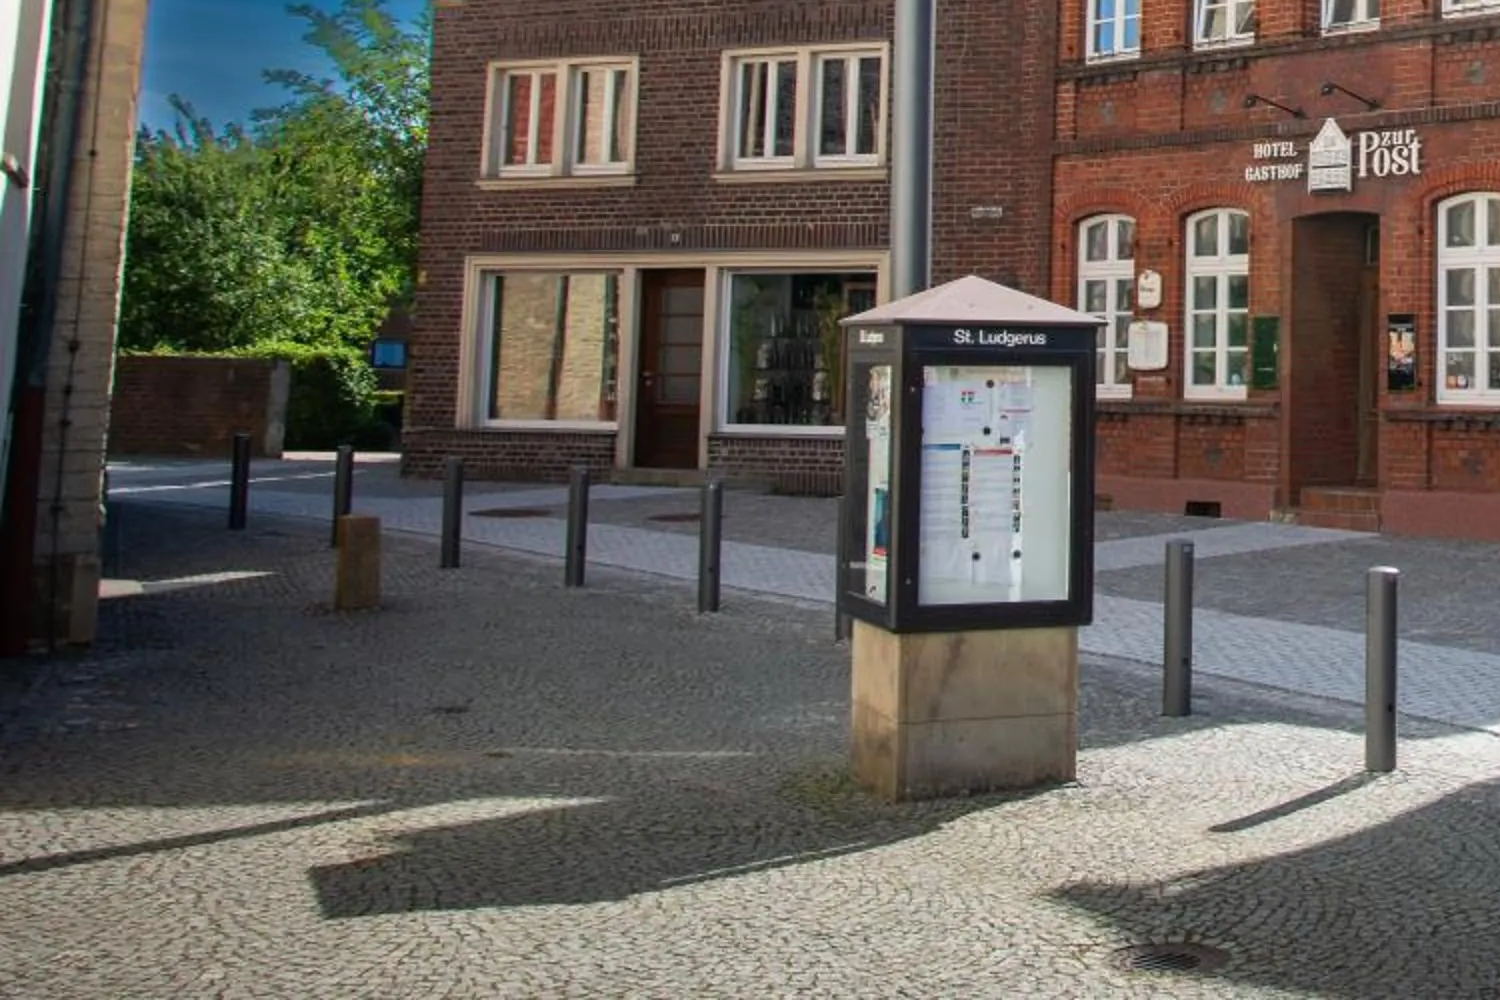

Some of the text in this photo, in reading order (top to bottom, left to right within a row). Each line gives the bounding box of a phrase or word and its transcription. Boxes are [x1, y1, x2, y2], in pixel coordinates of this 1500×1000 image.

[1381, 129, 1417, 147] zur
[1253, 141, 1298, 160] HOTEL
[1358, 131, 1422, 177] Post
[1245, 163, 1304, 182] GASTHOF
[953, 328, 1047, 347] St. Ludgerus
